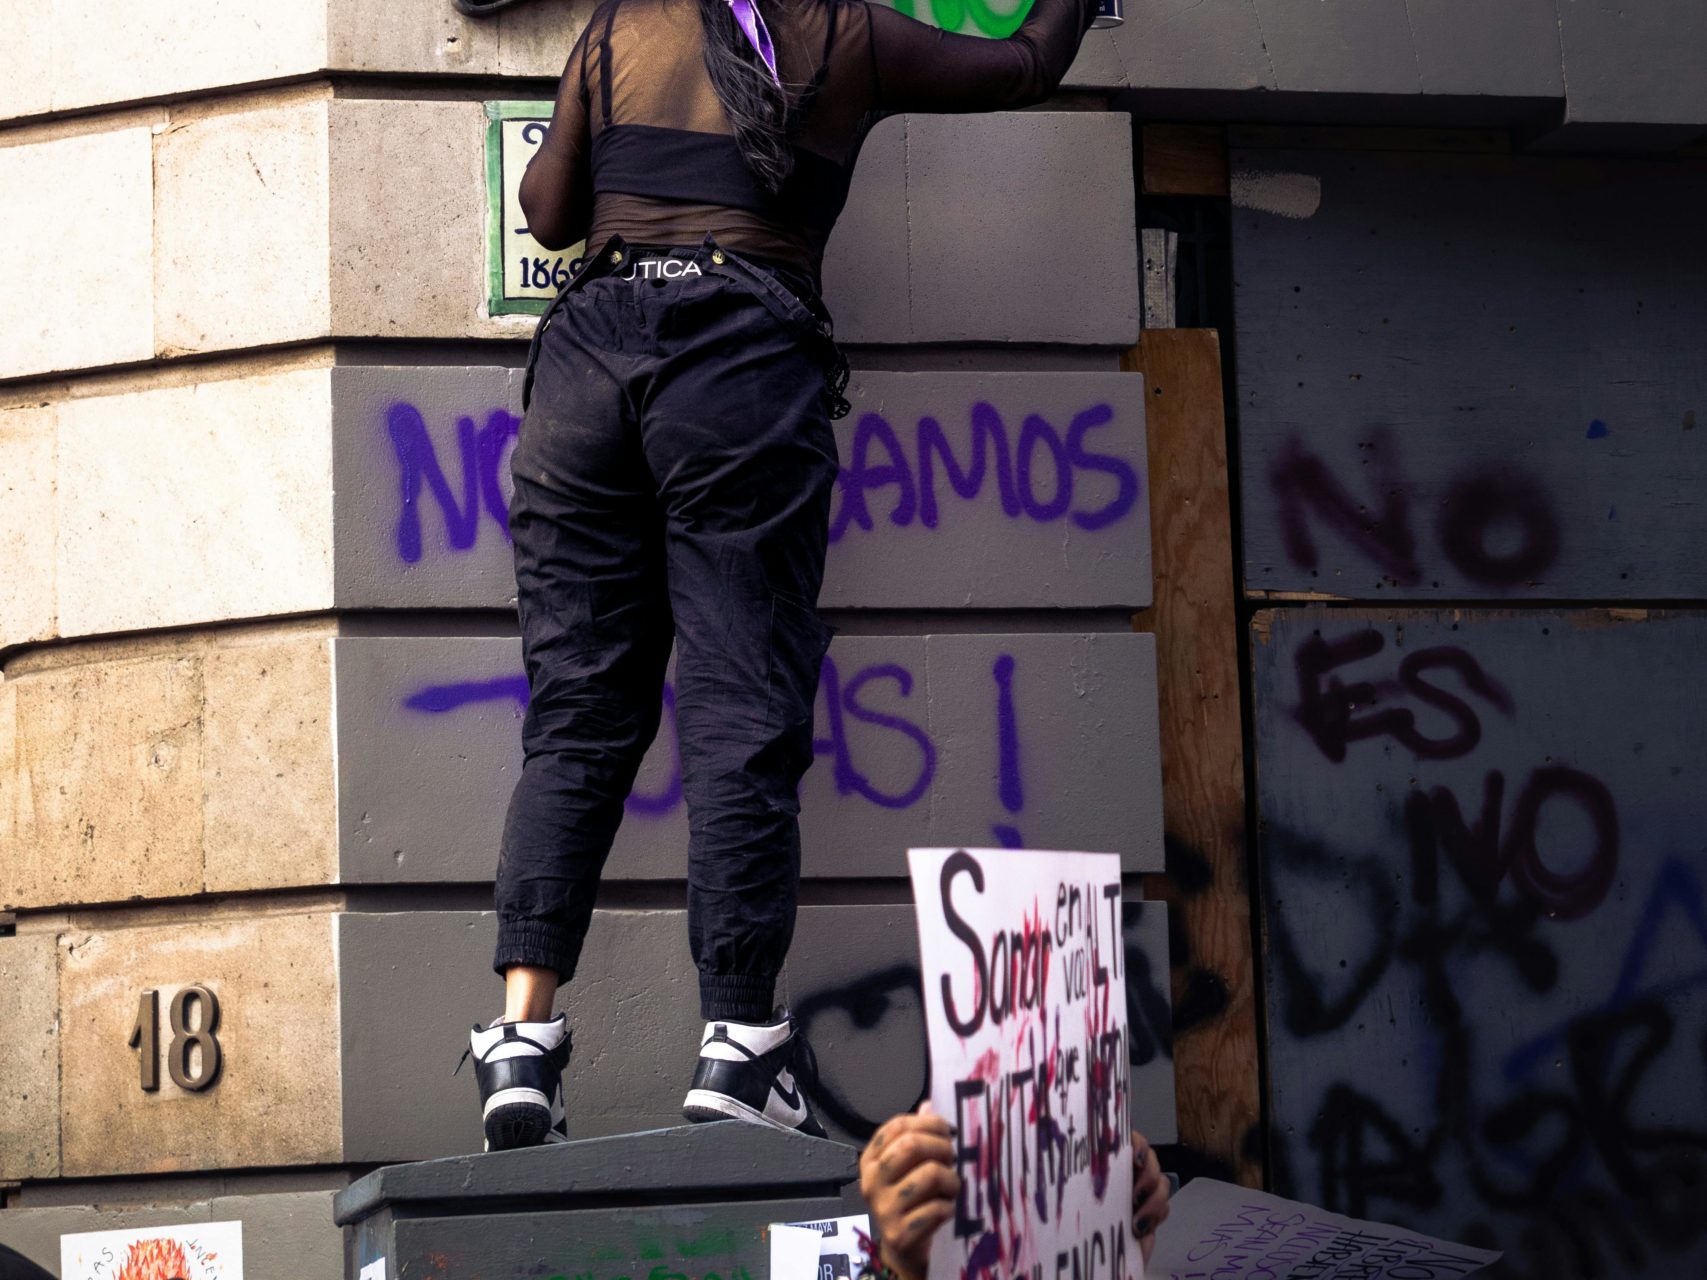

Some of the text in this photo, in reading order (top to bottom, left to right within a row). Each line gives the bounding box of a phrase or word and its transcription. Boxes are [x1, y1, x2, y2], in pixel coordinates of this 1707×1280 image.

[1272, 426, 1561, 590] NO
[1294, 630, 1514, 763] ES
[1403, 766, 1620, 921] NO
[1055, 881, 1082, 948] en
[128, 983, 223, 1092] 18
[1387, 1249, 1486, 1280] NO
